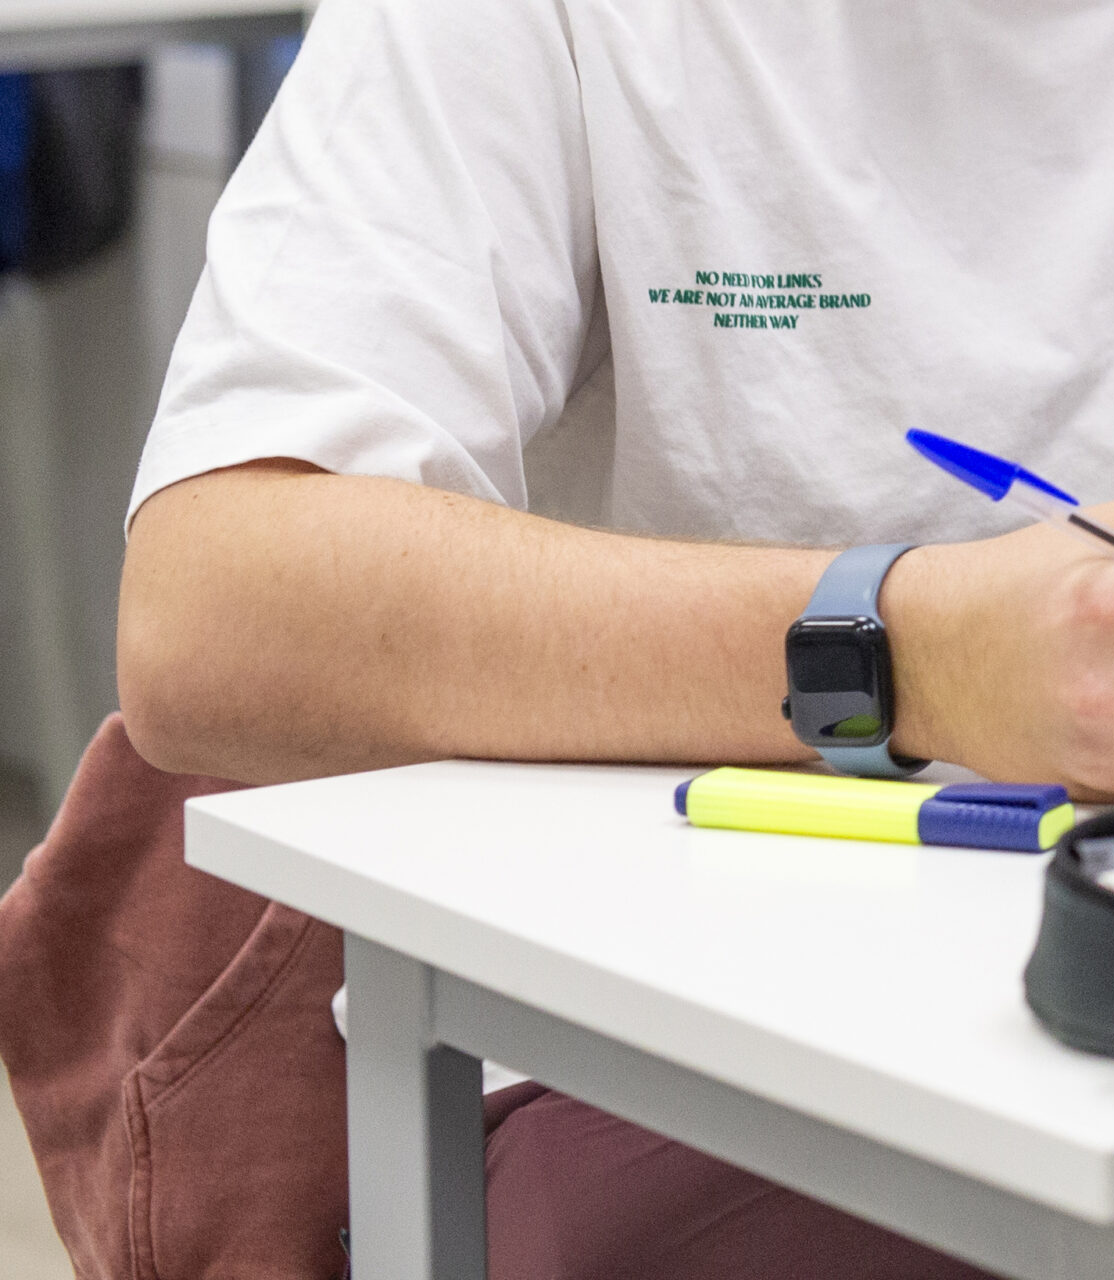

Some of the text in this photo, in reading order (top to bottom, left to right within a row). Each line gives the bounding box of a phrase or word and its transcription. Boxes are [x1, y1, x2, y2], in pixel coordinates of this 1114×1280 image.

[695, 270, 823, 289] NO NEED FOR LINKS
[648, 288, 872, 309] WE ARE NOT AN AVERAGE BRAND
[713, 313, 800, 329] NEITHER WAY
